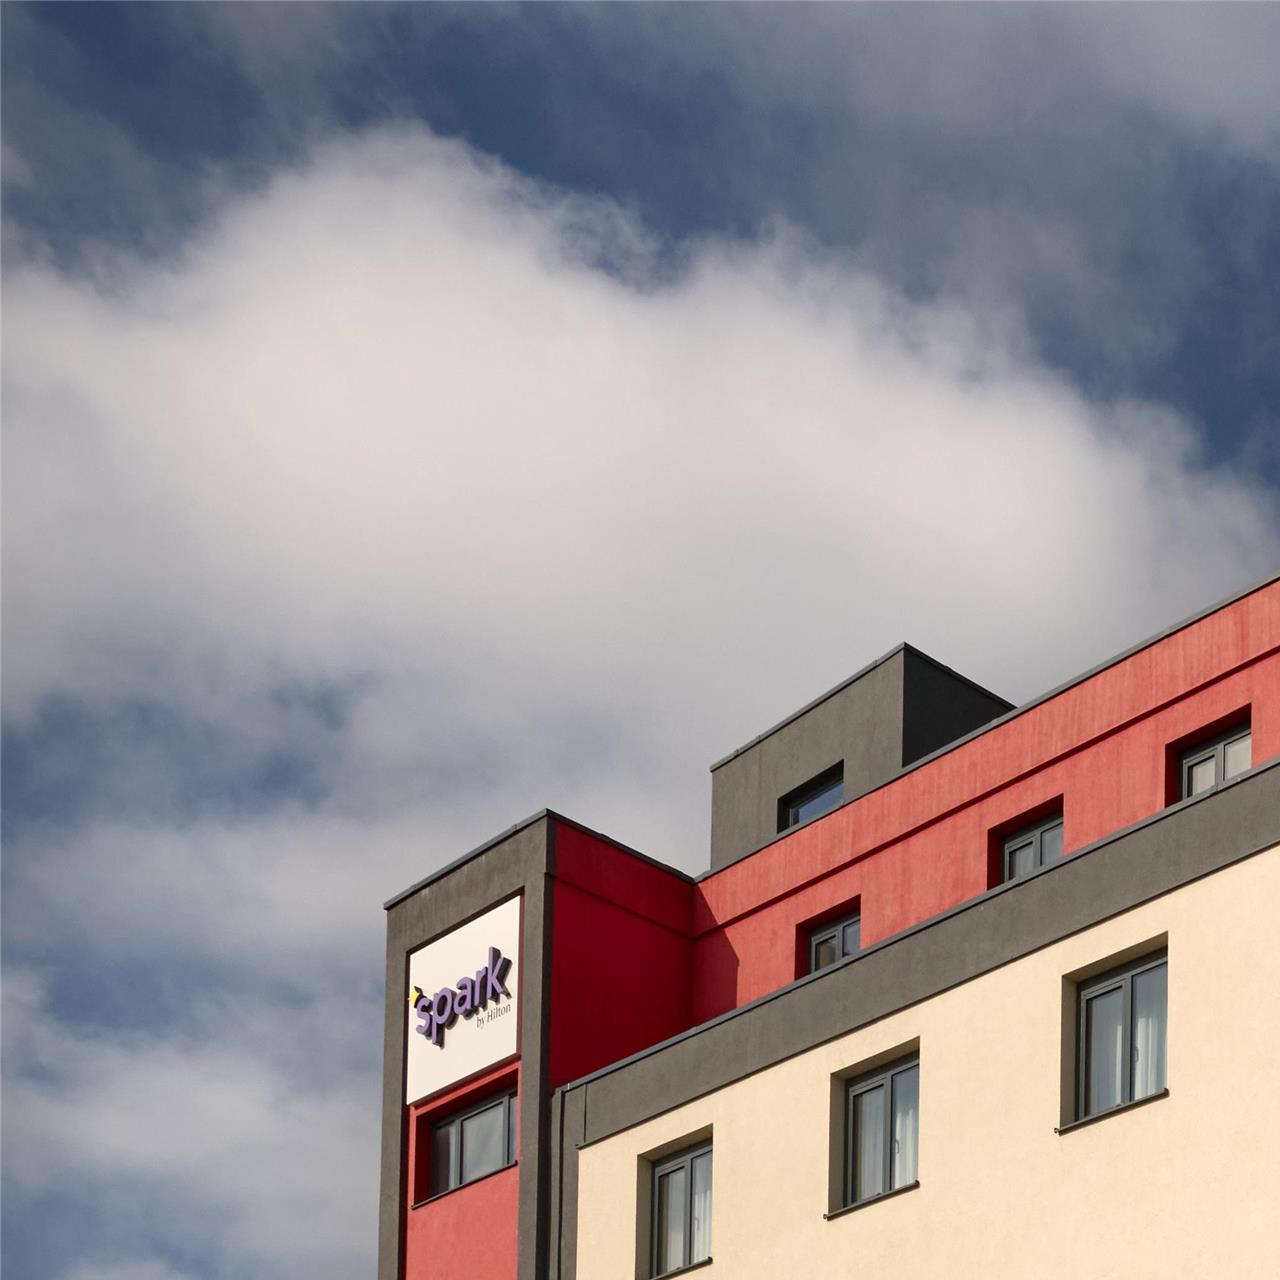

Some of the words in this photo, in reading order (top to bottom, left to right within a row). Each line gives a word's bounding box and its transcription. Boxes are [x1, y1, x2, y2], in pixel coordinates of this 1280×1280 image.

[415, 946, 513, 1048] spark
[476, 1014, 487, 1029] by
[486, 1002, 511, 1024] Hilton
